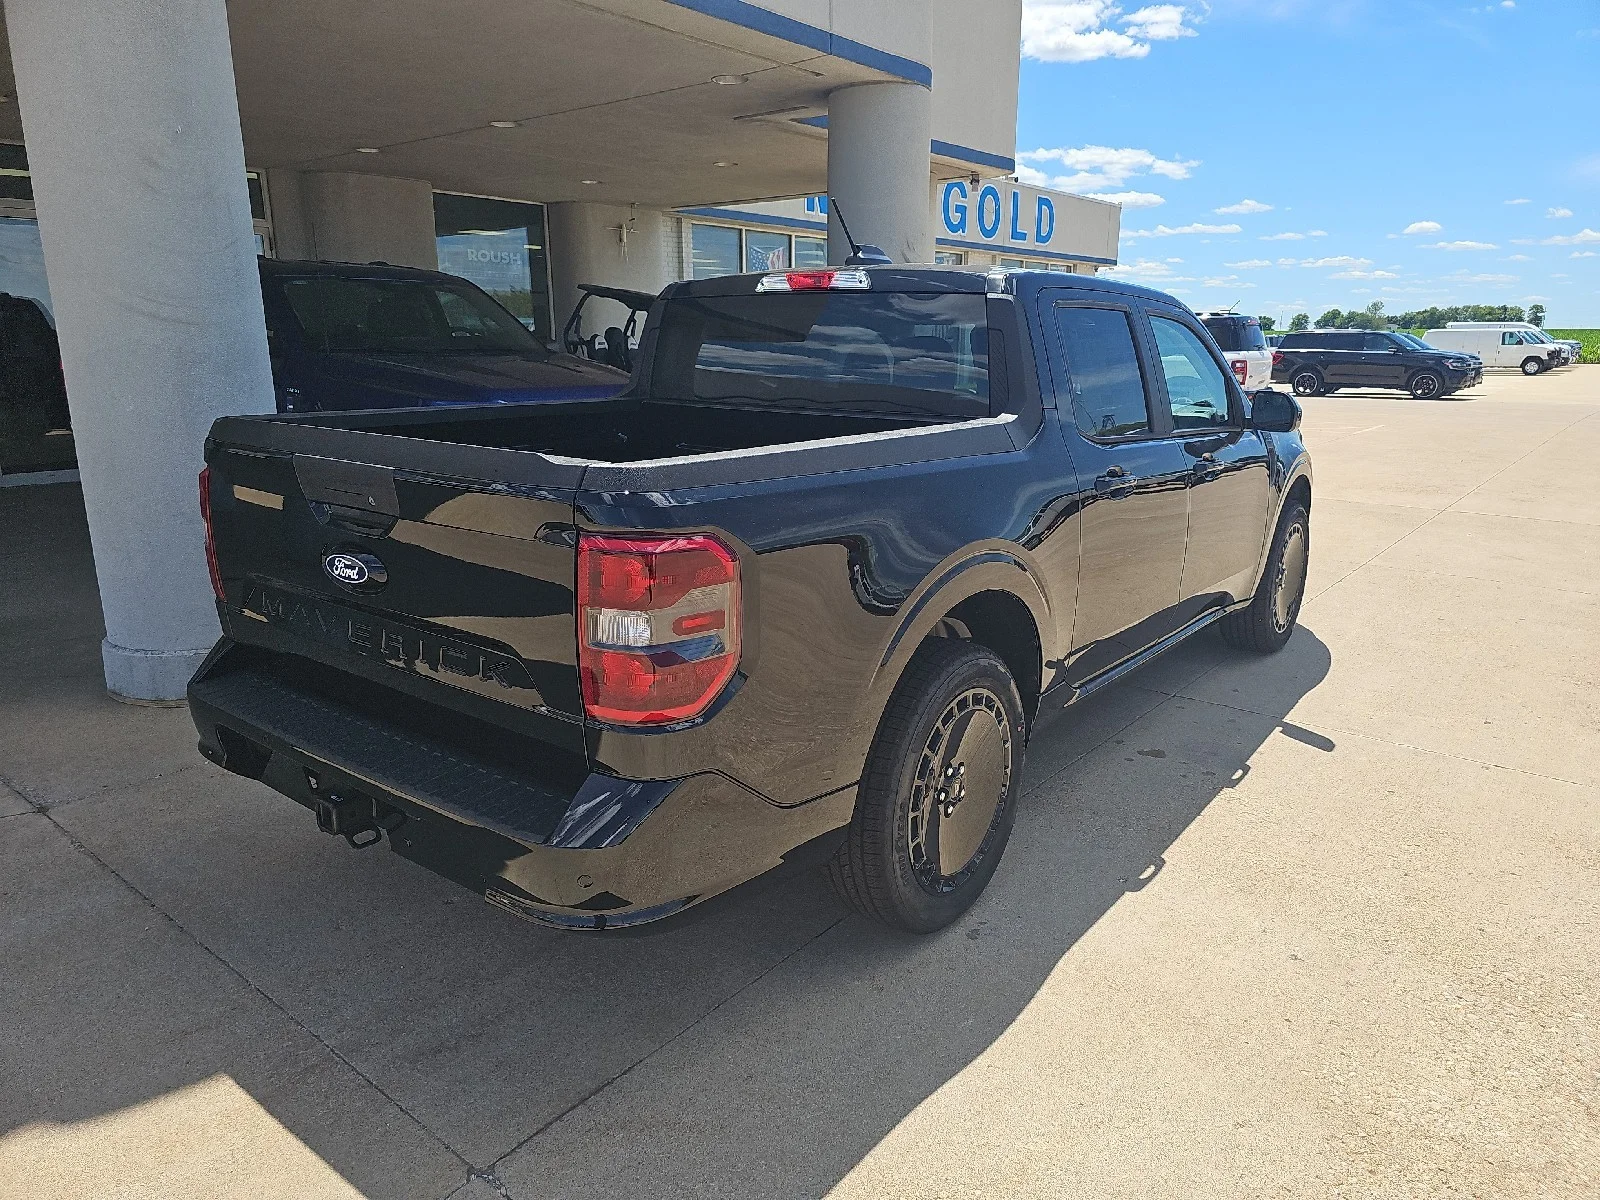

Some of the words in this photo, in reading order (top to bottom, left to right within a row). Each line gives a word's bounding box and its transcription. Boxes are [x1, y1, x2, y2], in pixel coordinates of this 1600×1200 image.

[942, 181, 1055, 245] GOLD
[467, 248, 522, 265] ROUSH
[261, 591, 511, 689] MAVERICK
